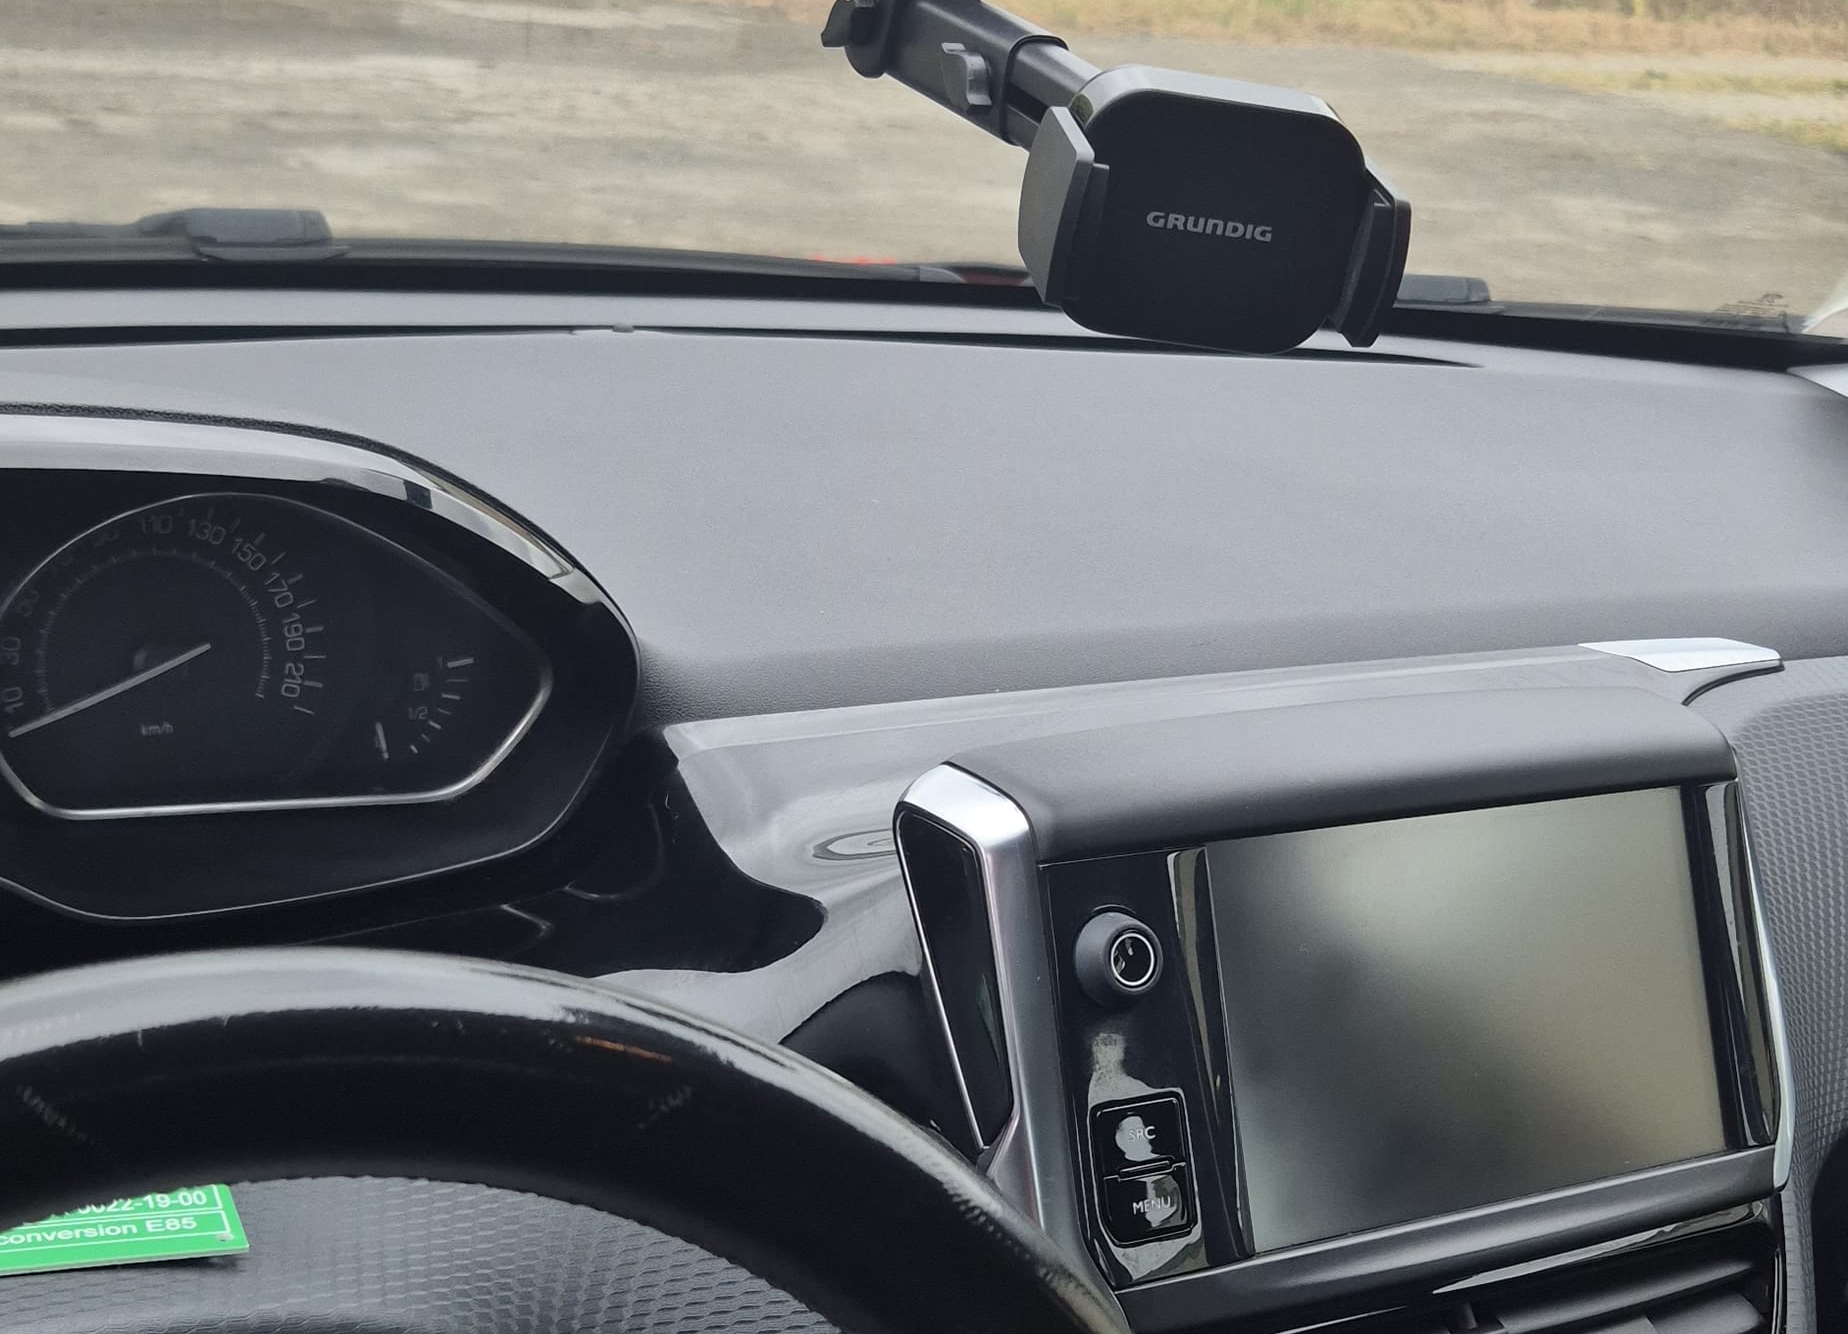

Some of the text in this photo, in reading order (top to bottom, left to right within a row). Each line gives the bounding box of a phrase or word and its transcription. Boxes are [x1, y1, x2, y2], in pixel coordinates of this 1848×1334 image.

[1146, 211, 1272, 242] GRUNDIG
[139, 514, 173, 535] 110
[187, 518, 226, 545] 130
[231, 538, 266, 570] 150
[264, 572, 294, 608] 170
[282, 613, 305, 651] 190
[281, 663, 305, 698] 210
[3, 686, 25, 714] 10
[140, 722, 174, 736] km/h
[1128, 1126, 1156, 1142] SRC
[1132, 1195, 1171, 1215] MENU
[145, 1217, 197, 1232] E85
